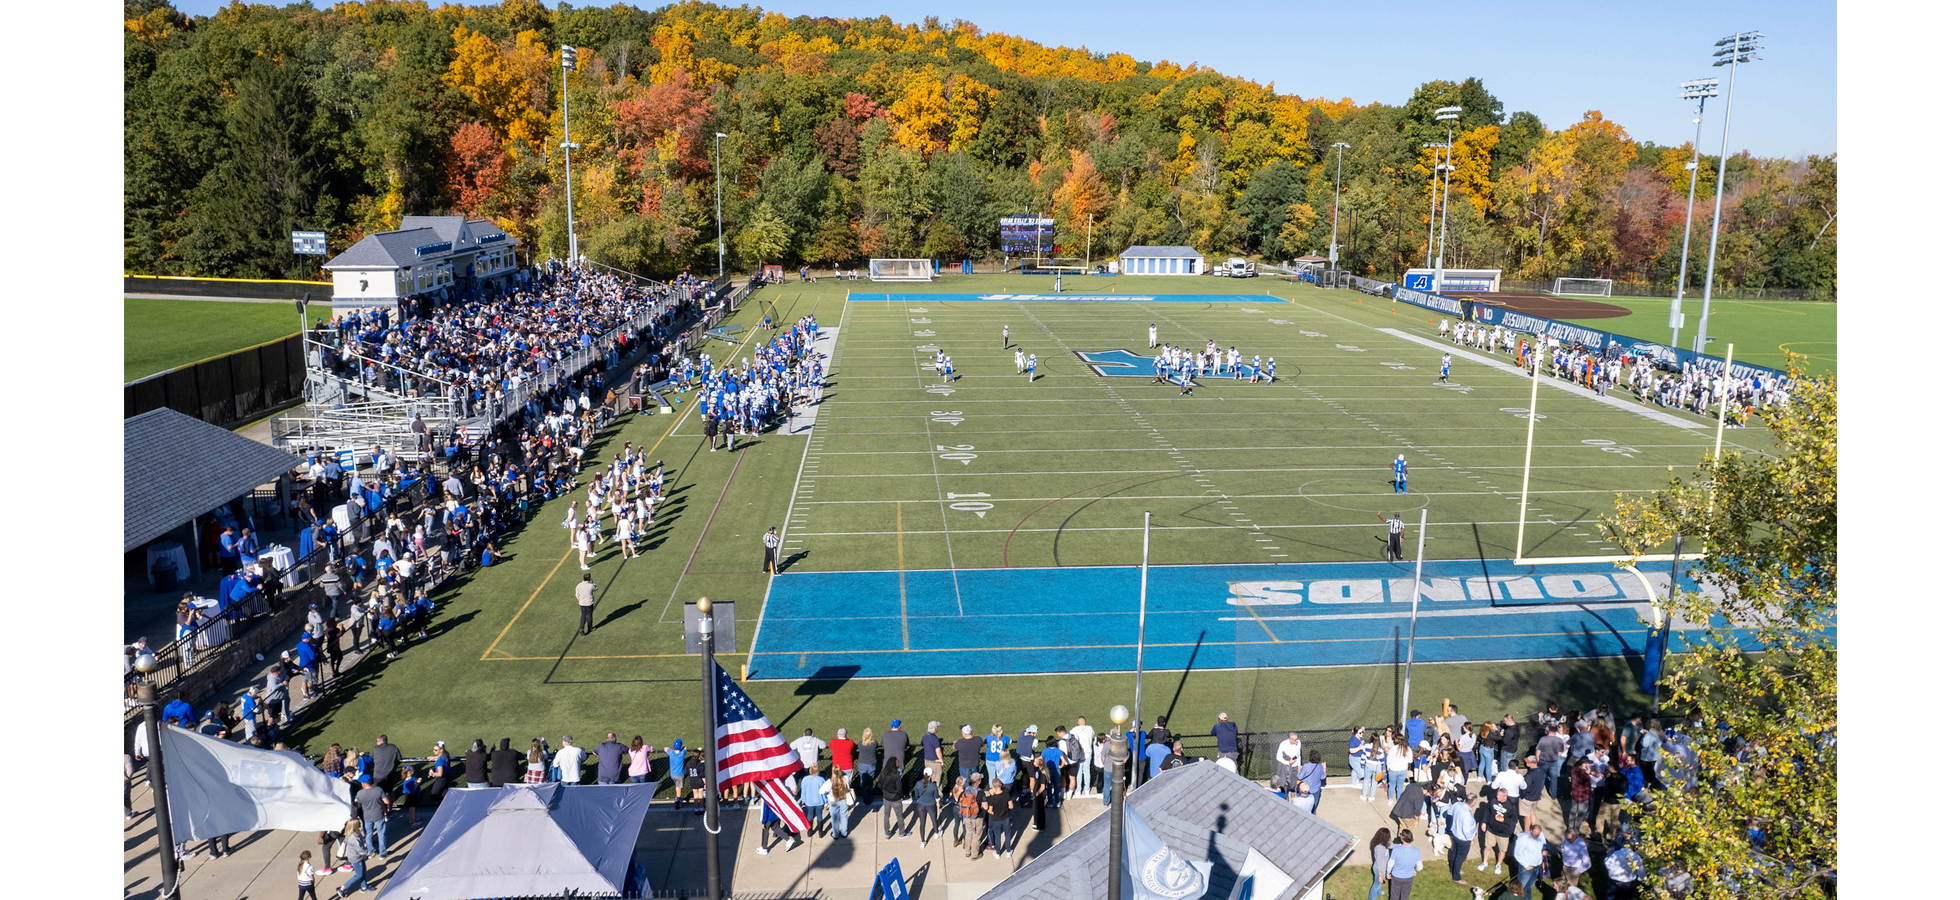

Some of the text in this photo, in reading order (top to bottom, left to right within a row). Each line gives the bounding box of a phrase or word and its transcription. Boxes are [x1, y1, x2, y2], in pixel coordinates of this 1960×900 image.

[1413, 276, 1428, 289] A
[1396, 288, 1463, 314] ASSUMPTION GREYHOUND
[1501, 312, 1603, 348] ASSUMPTION GREYHOUNDS
[930, 410, 965, 422] 30
[936, 444, 978, 460] 20
[946, 491, 994, 511] 10
[990, 740, 1003, 753] 83
